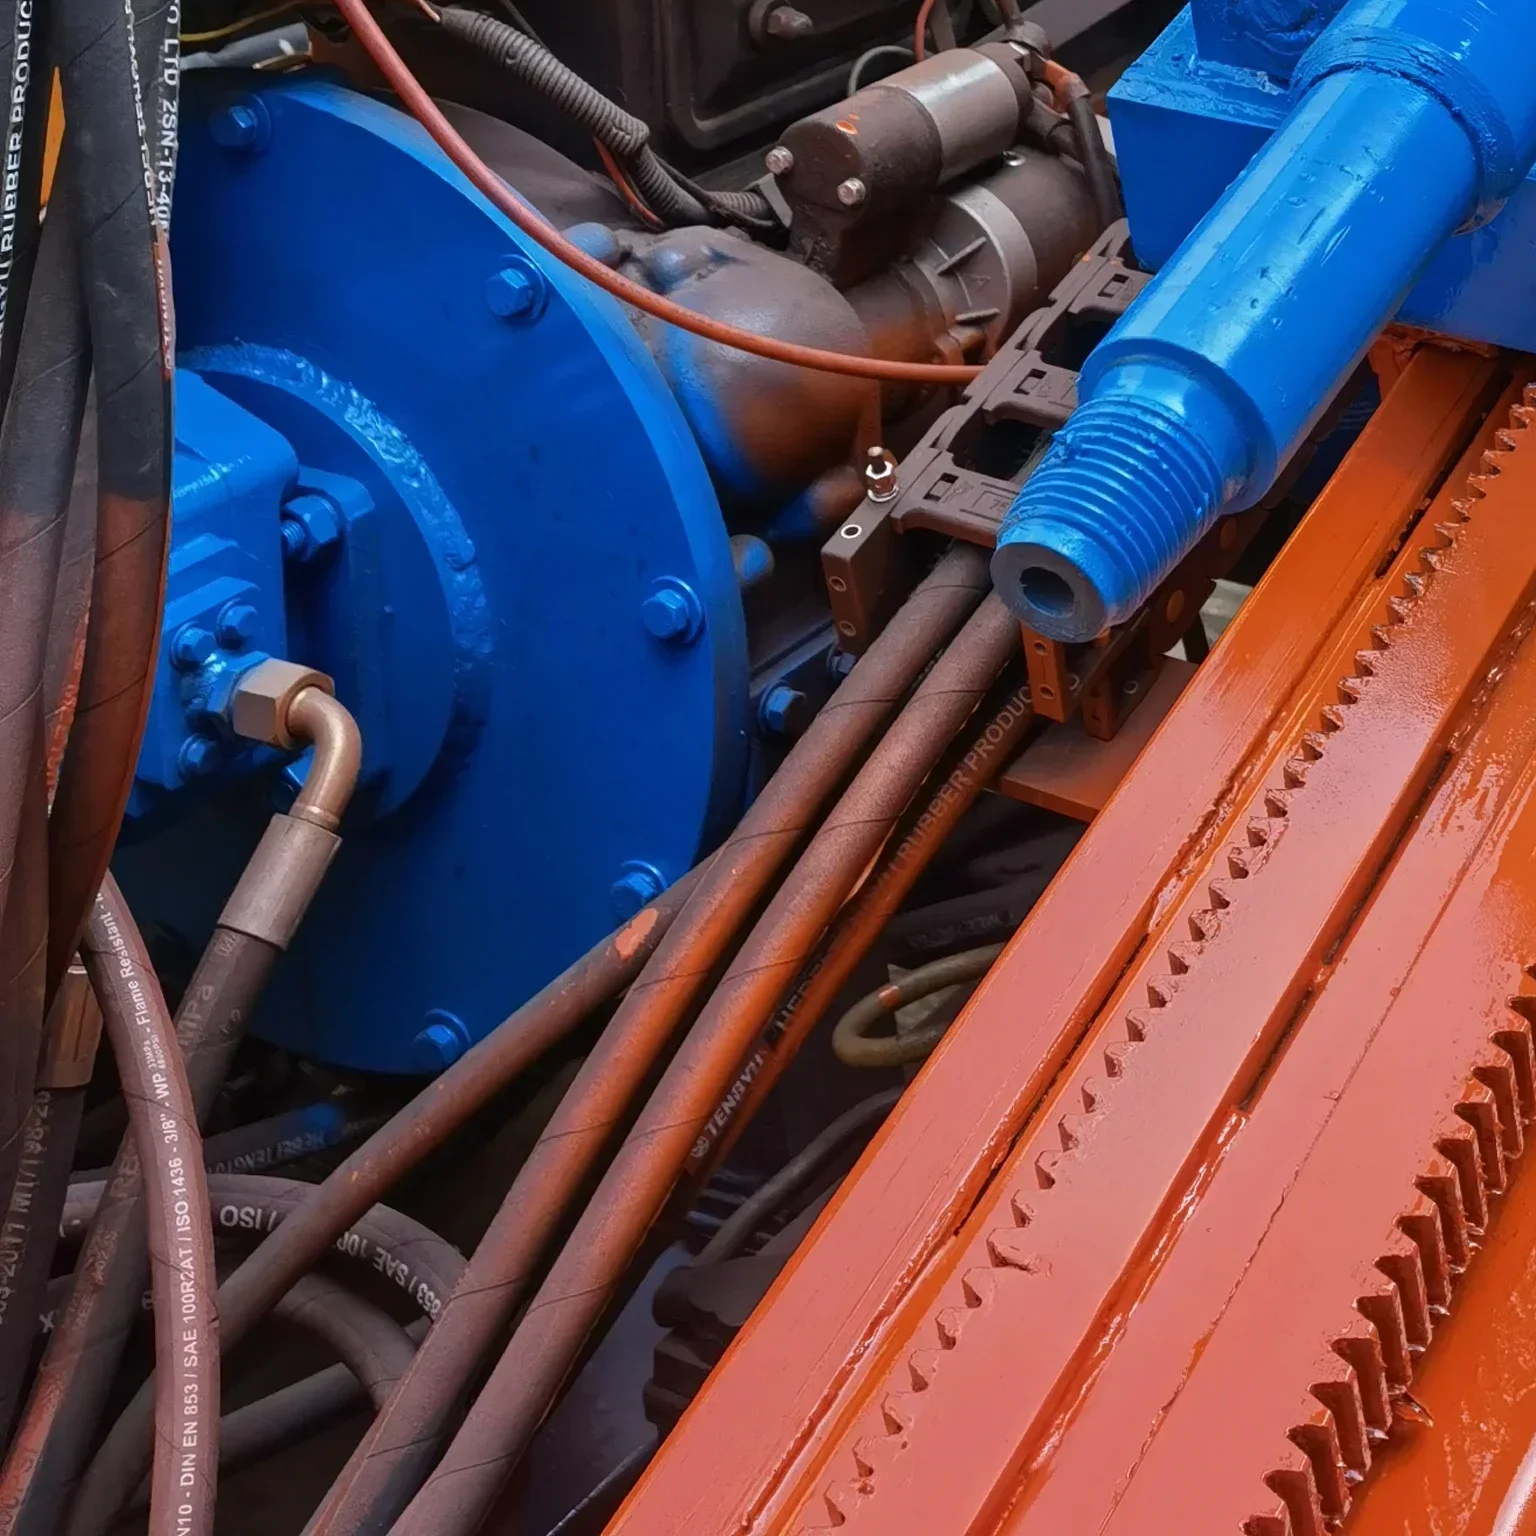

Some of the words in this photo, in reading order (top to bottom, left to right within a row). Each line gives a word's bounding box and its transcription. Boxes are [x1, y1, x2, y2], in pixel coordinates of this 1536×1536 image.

[163, 38, 179, 86] LTD
[1, 132, 22, 252] RUBBER
[963, 683, 1036, 778] PRODUC
[100, 912, 135, 978] Resistant
[128, 980, 151, 1026] Flame
[152, 1073, 170, 1100] WP
[168, 1157, 187, 1197] 1436
[174, 1200, 191, 1233] ISO
[219, 1204, 264, 1231] ISO
[179, 1248, 197, 1323] 100R2AT
[183, 1328, 198, 1368] SAE
[183, 1383, 198, 1416] 853
[183, 1420, 198, 1448] EN
[180, 1451, 197, 1487] DIN
